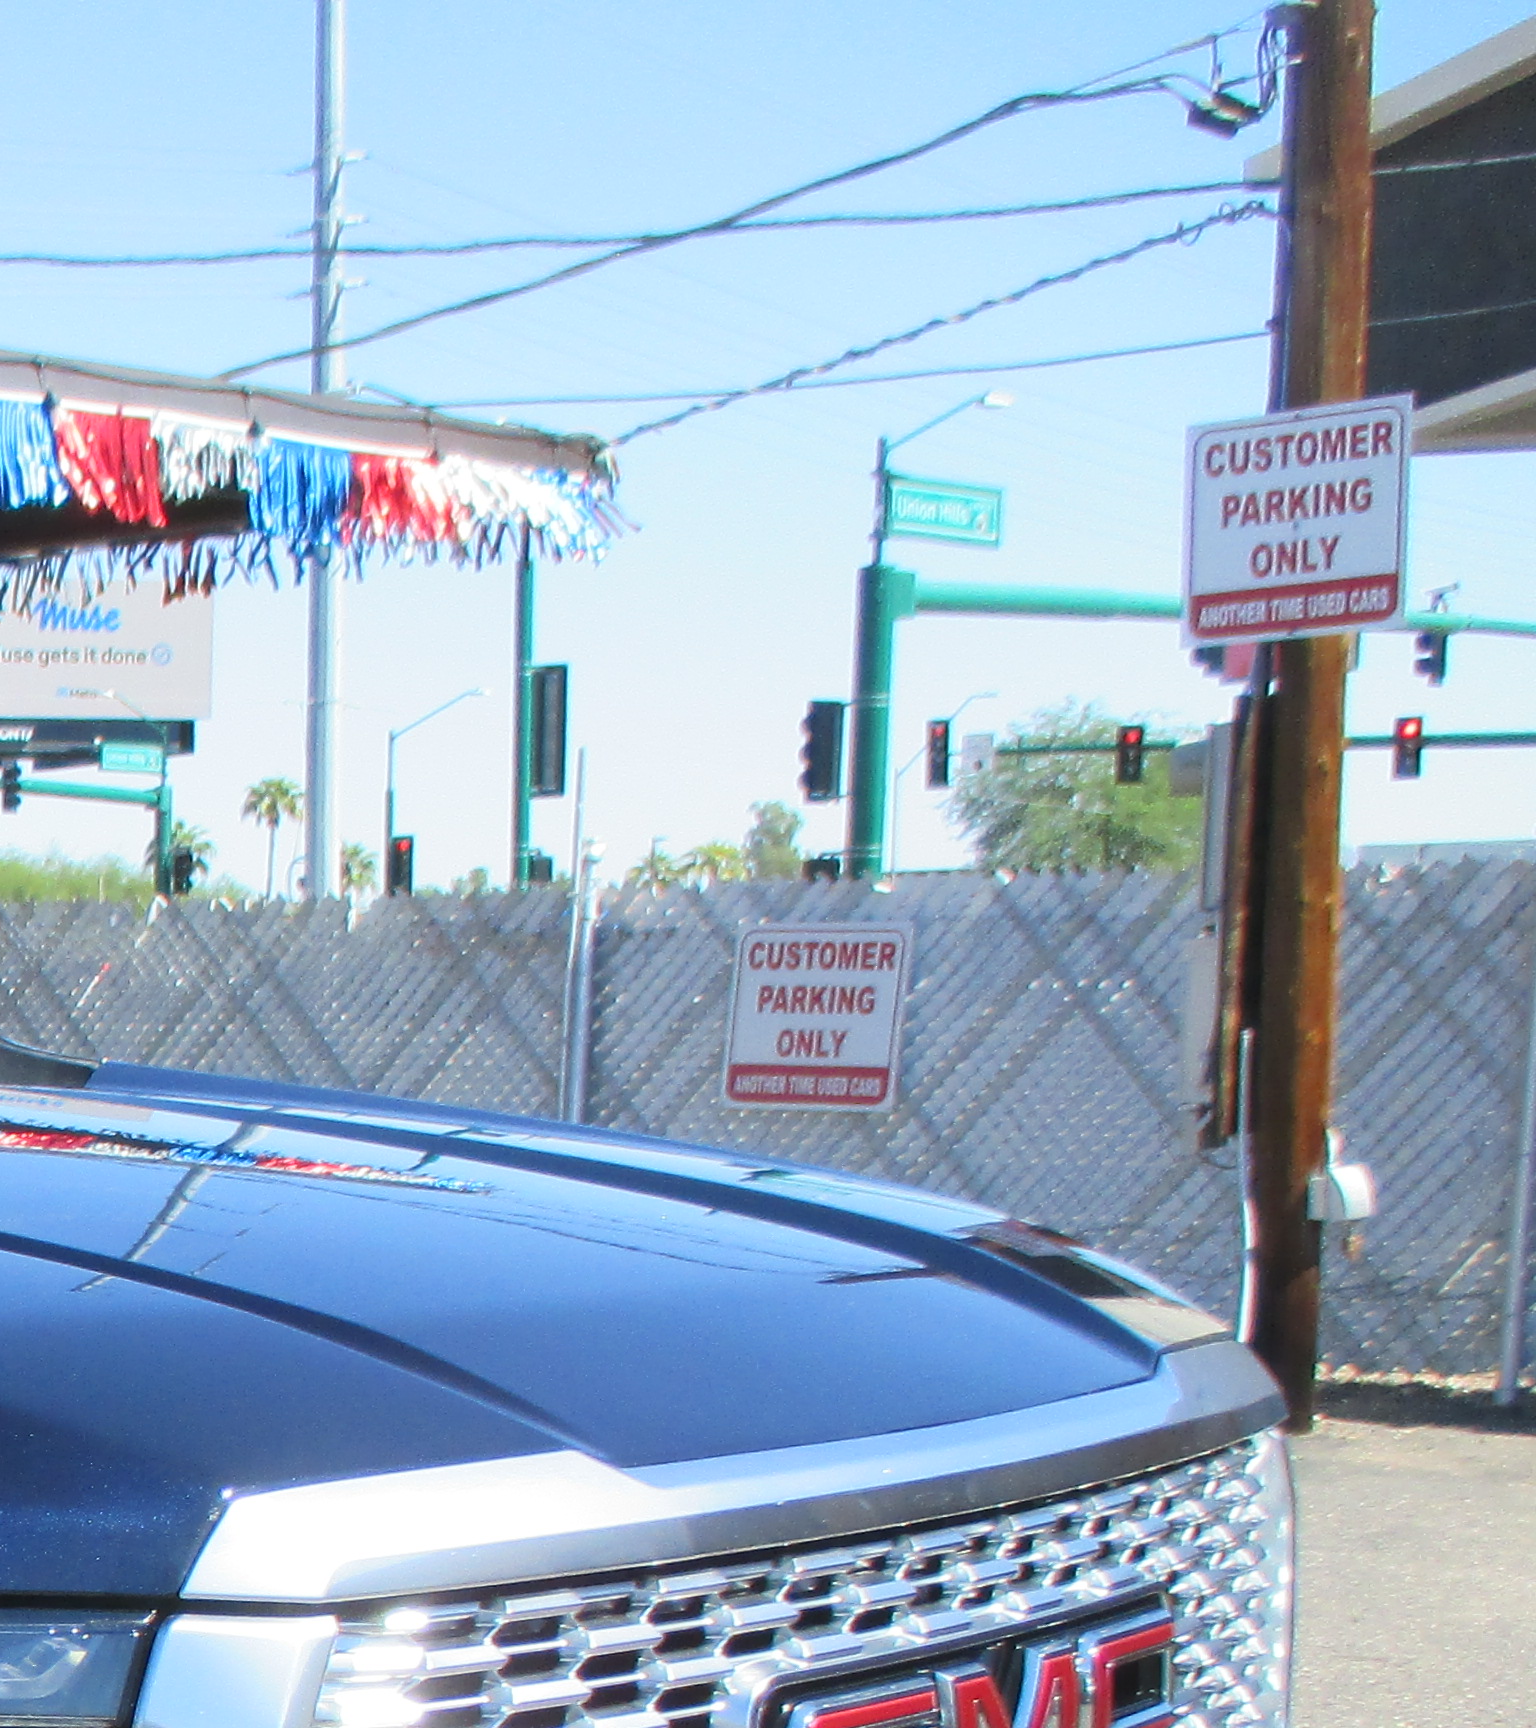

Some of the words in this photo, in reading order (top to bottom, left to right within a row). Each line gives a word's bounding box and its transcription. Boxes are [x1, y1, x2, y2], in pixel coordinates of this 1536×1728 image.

[1203, 421, 1394, 478] CUSTOMER
[897, 495, 936, 521] Union
[939, 501, 969, 526] Hills
[1220, 478, 1373, 529] PARKING
[1249, 535, 1341, 578] ONLY
[33, 598, 122, 632] Muse
[1197, 600, 1266, 630] ANOTHER
[1269, 597, 1304, 622] TIME
[1307, 591, 1346, 619] USED
[1349, 586, 1390, 614] CARS
[38, 646, 79, 668] gets
[83, 646, 96, 664] it
[101, 646, 147, 665] done
[748, 941, 897, 971] CUSTOMER
[756, 985, 875, 1015] PARKING
[776, 1028, 847, 1058] ONLY
[733, 1075, 786, 1094] ANOTHER
[789, 1075, 815, 1095] TIME
[817, 1076, 848, 1096] USED
[850, 1077, 880, 1097] CARS
